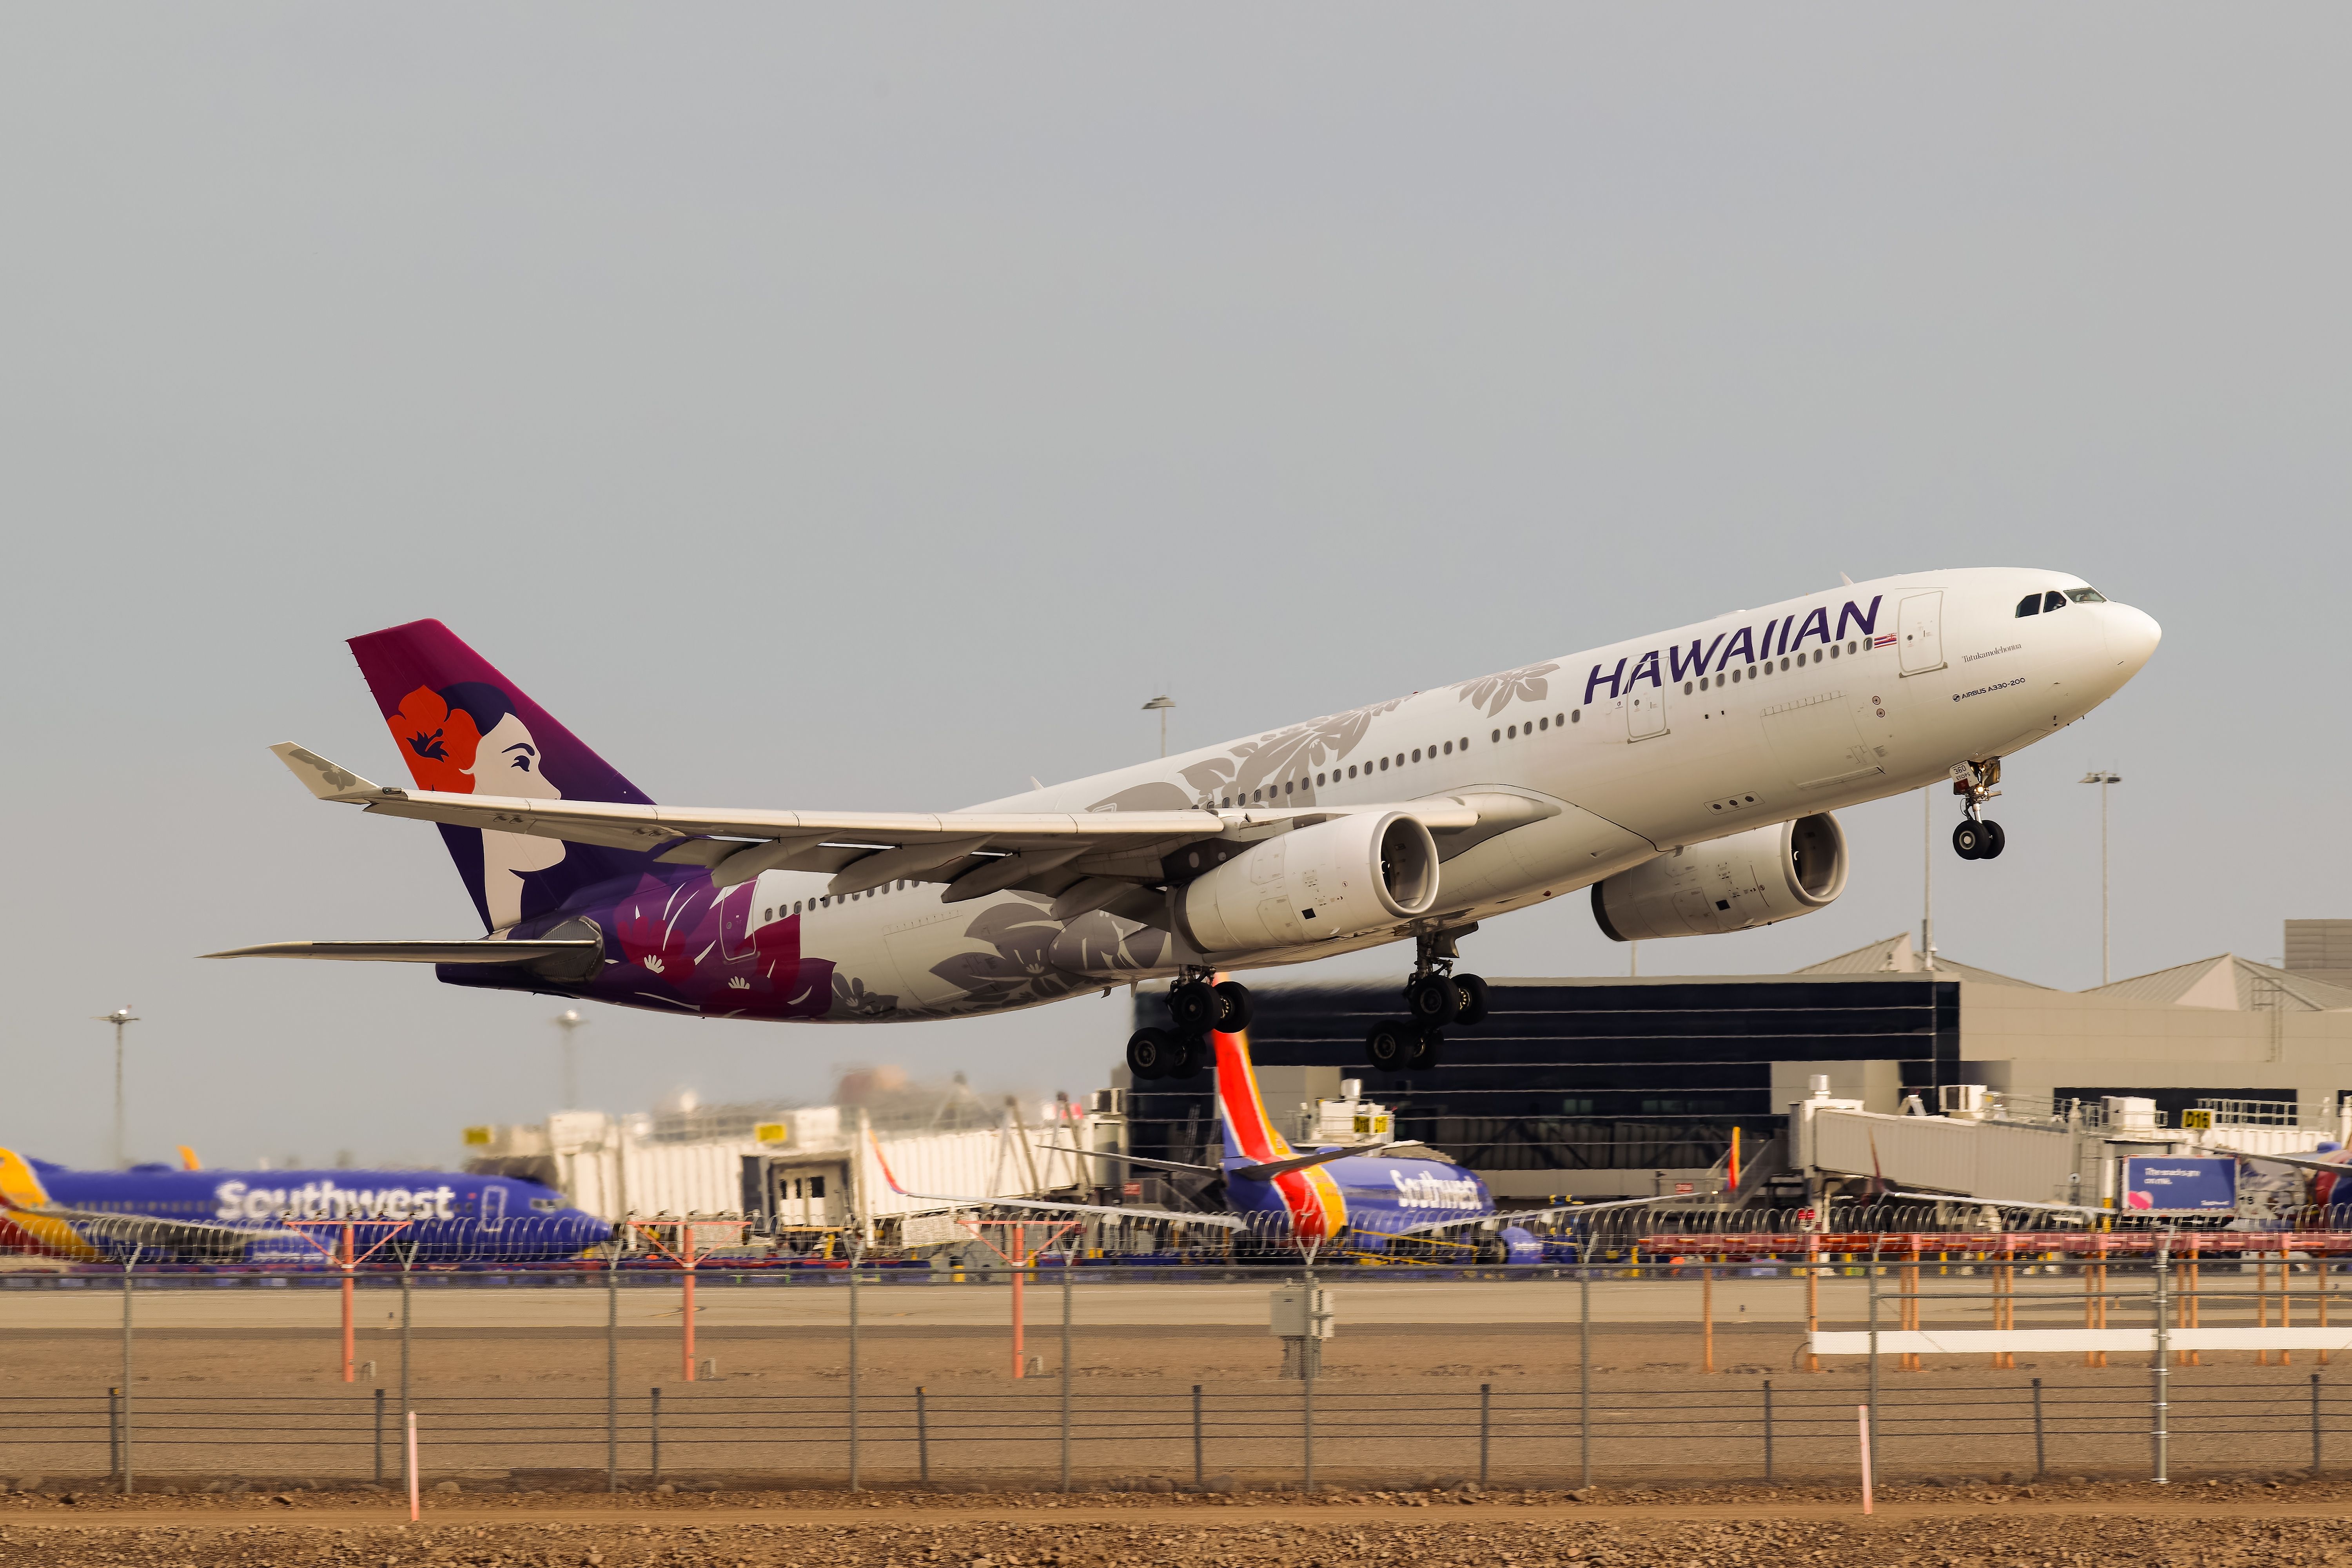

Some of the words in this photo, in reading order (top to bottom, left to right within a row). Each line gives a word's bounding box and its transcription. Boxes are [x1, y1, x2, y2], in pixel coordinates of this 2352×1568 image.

[1584, 595, 1883, 704] HAWAIIAN
[1962, 688, 1987, 699] AIRBUS
[1988, 677, 2026, 692] A330-200
[1953, 765, 1967, 775] 360
[1956, 772, 1971, 781] ETOPS
[215, 1180, 456, 1221] Southwest
[1390, 1169, 1483, 1210] Southwest
